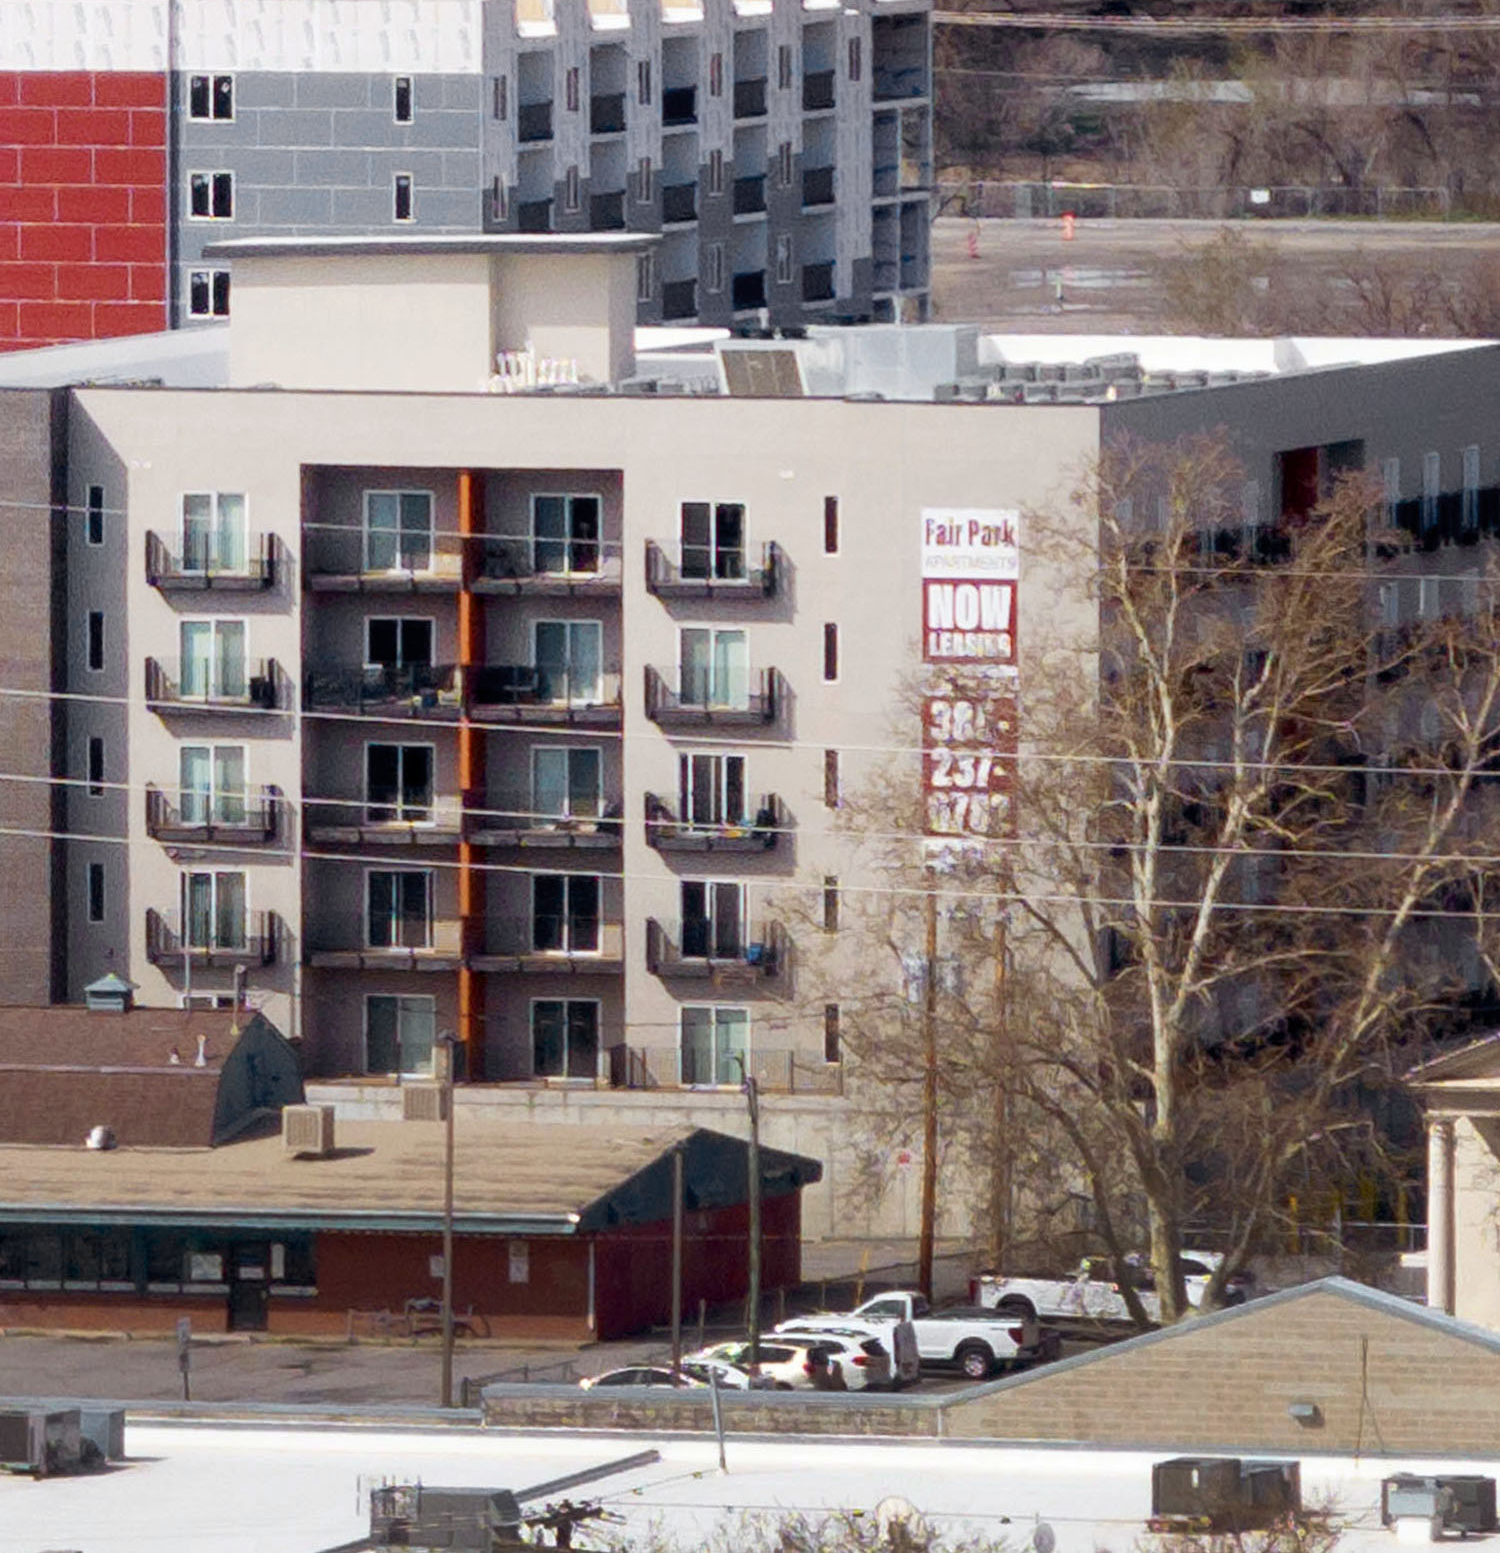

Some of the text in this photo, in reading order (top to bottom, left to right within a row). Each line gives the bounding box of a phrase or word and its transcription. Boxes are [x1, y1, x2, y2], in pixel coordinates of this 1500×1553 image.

[925, 518, 1016, 547] Fair Park
[928, 584, 1012, 630] NOW
[929, 632, 1012, 657] LEASING
